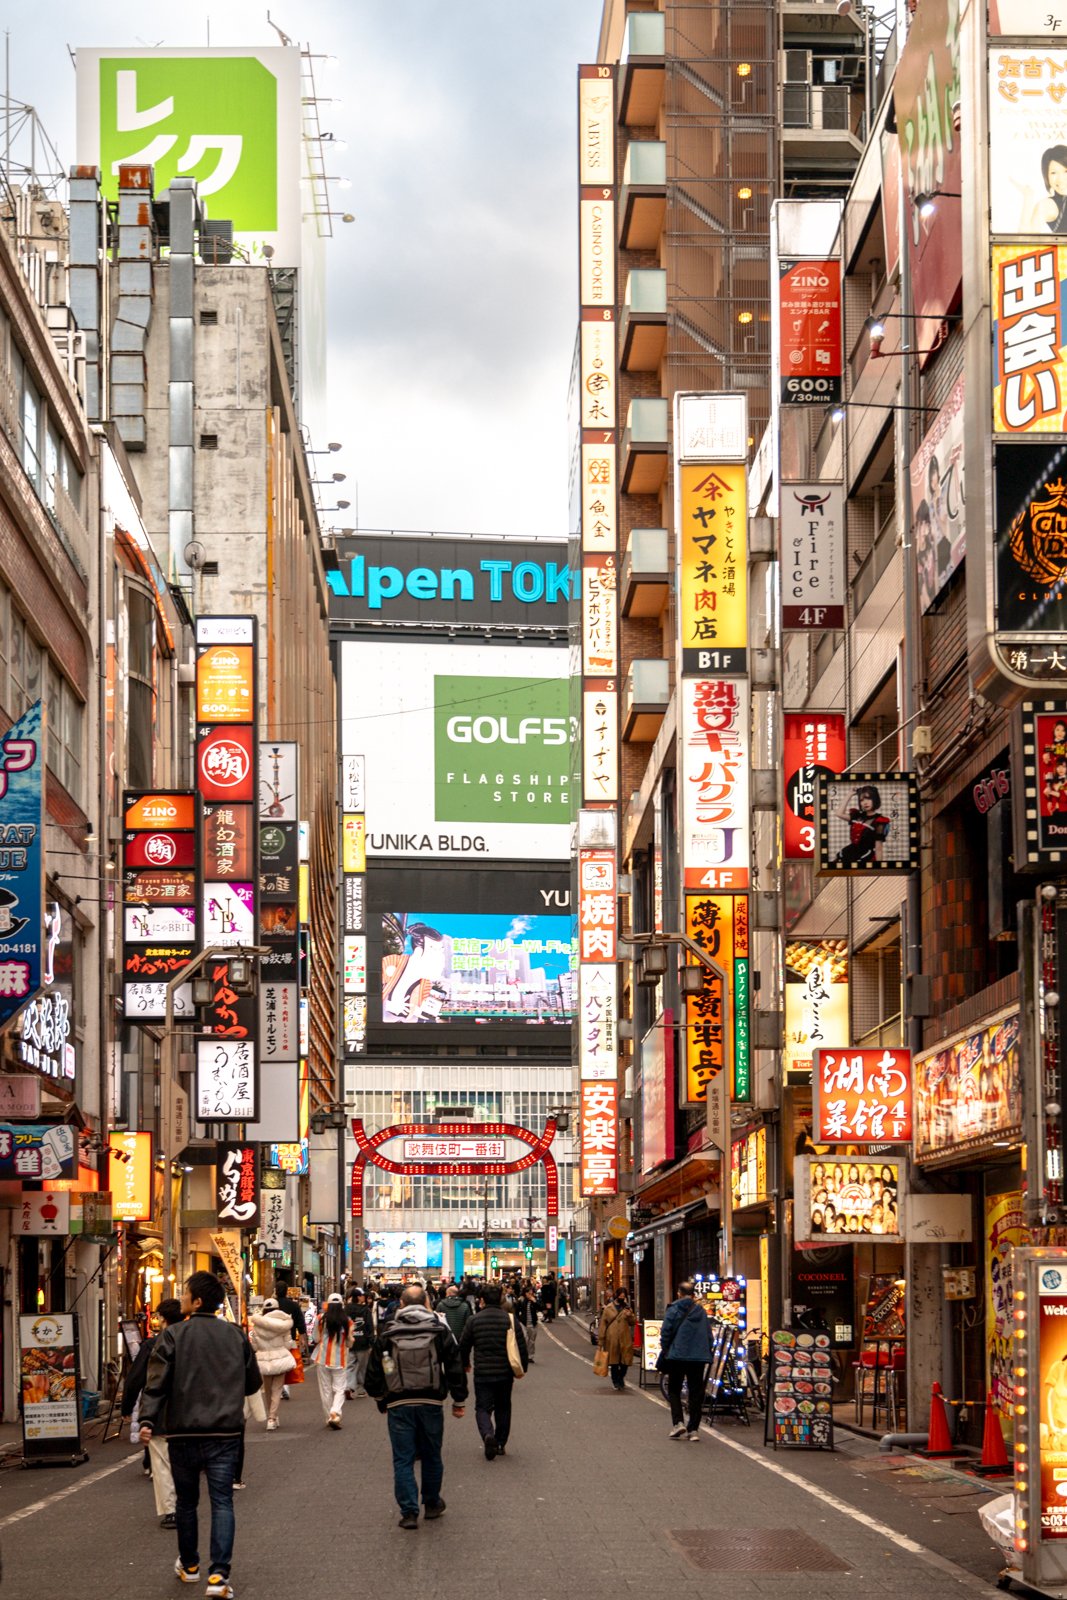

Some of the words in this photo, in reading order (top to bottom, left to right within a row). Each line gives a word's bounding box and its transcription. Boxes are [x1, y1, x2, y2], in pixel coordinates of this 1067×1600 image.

[597, 67, 610, 78] 10
[603, 189, 611, 199] 9
[591, 206, 603, 257] CASINO
[790, 276, 830, 287] ZINO
[603, 310, 611, 320] 8
[1001, 250, 1058, 428] 出会い
[787, 378, 830, 393] 600
[603, 432, 610, 443] 7
[722, 506, 736, 597] やきとん酒場
[808, 521, 820, 588] Fire
[605, 556, 613, 566] 6
[691, 506, 718, 641] ヤマネ肉店
[793, 551, 803, 598] Ice
[1018, 592, 1064, 601] CLUB
[798, 608, 828, 625] 4F
[210, 657, 240, 665] ZINO
[698, 651, 731, 668] B1F
[1010, 651, 1067, 671] 第一大
[606, 681, 614, 690] 5
[447, 716, 568, 745] GOLF5
[689, 681, 744, 824] 熟女キャバクラ
[348, 759, 360, 808] 小松ビル
[447, 773, 569, 786] FLAGSHIP
[493, 791, 569, 804] STORE
[973, 769, 1009, 814] Girls
[143, 807, 177, 817] ZINO
[216, 809, 236, 874] 龍幻酒家
[438, 835, 490, 853] BLDG.
[700, 870, 733, 888] 4F
[135, 885, 191, 897] 龍幻酒家
[236, 887, 253, 898] 2F
[540, 890, 571, 907] YU
[181, 909, 195, 918] 2F
[581, 894, 616, 958] 焼肉
[735, 902, 748, 950] 炭火串焼
[265, 988, 277, 1055] 芝浦ホルモン
[347, 1041, 364, 1052] 7F
[231, 1042, 250, 1101] 居酒屋
[824, 1050, 907, 1098] 湖南
[890, 1099, 907, 1138] 4F
[14, 1134, 43, 1144] フリー
[583, 1084, 616, 1185] 安楽亭
[408, 1142, 502, 1157] 歌舞伎町一番街
[14, 1150, 41, 1174] 雀
[798, 1273, 847, 1281] COCONEEL
[694, 1281, 711, 1293] 4F
[1050, 1514, 1067, 1527] 03-
